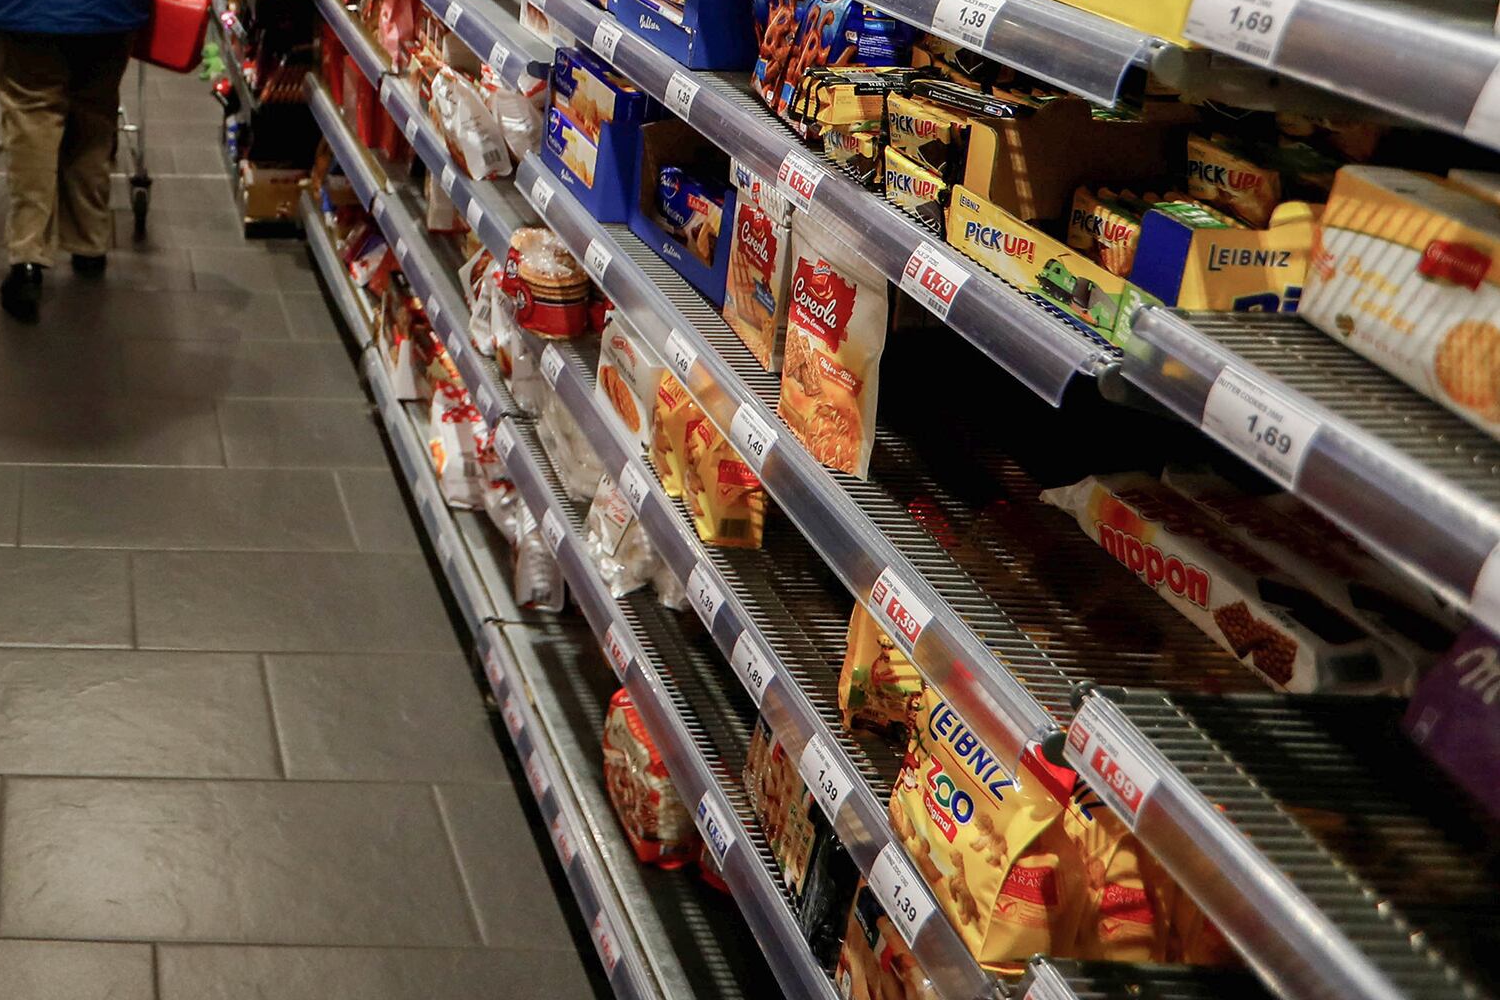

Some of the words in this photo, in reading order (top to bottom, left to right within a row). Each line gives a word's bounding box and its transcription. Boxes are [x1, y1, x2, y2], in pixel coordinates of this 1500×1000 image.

[959, 7, 986, 28] 1,39
[1229, 5, 1274, 35] 1,69
[677, 88, 690, 105] 1,39
[914, 119, 937, 138] UP!
[792, 171, 812, 198] 1,79
[912, 179, 935, 200] UP!
[1228, 170, 1263, 193] UP!
[960, 194, 980, 213] LEIBNIZ
[741, 221, 769, 263] Cereola
[1004, 234, 1036, 263] UP!
[1209, 242, 1291, 272] LEIBNIZ
[923, 269, 954, 296] 1,79
[794, 277, 837, 329] Cereola
[674, 352, 688, 372] 1,49
[746, 433, 763, 456] 1,49
[1248, 414, 1292, 455] 1,69
[1096, 521, 1211, 610] nippon
[699, 588, 714, 613] 1,39
[891, 604, 918, 636] 1,39
[746, 661, 763, 688] 1,89
[930, 701, 1014, 801] LEIBNIZ
[818, 768, 839, 802] 1,39
[926, 754, 974, 826] ZOO
[1099, 754, 1137, 800] 1,99
[924, 796, 952, 836] Original
[892, 884, 917, 924] 1,39
